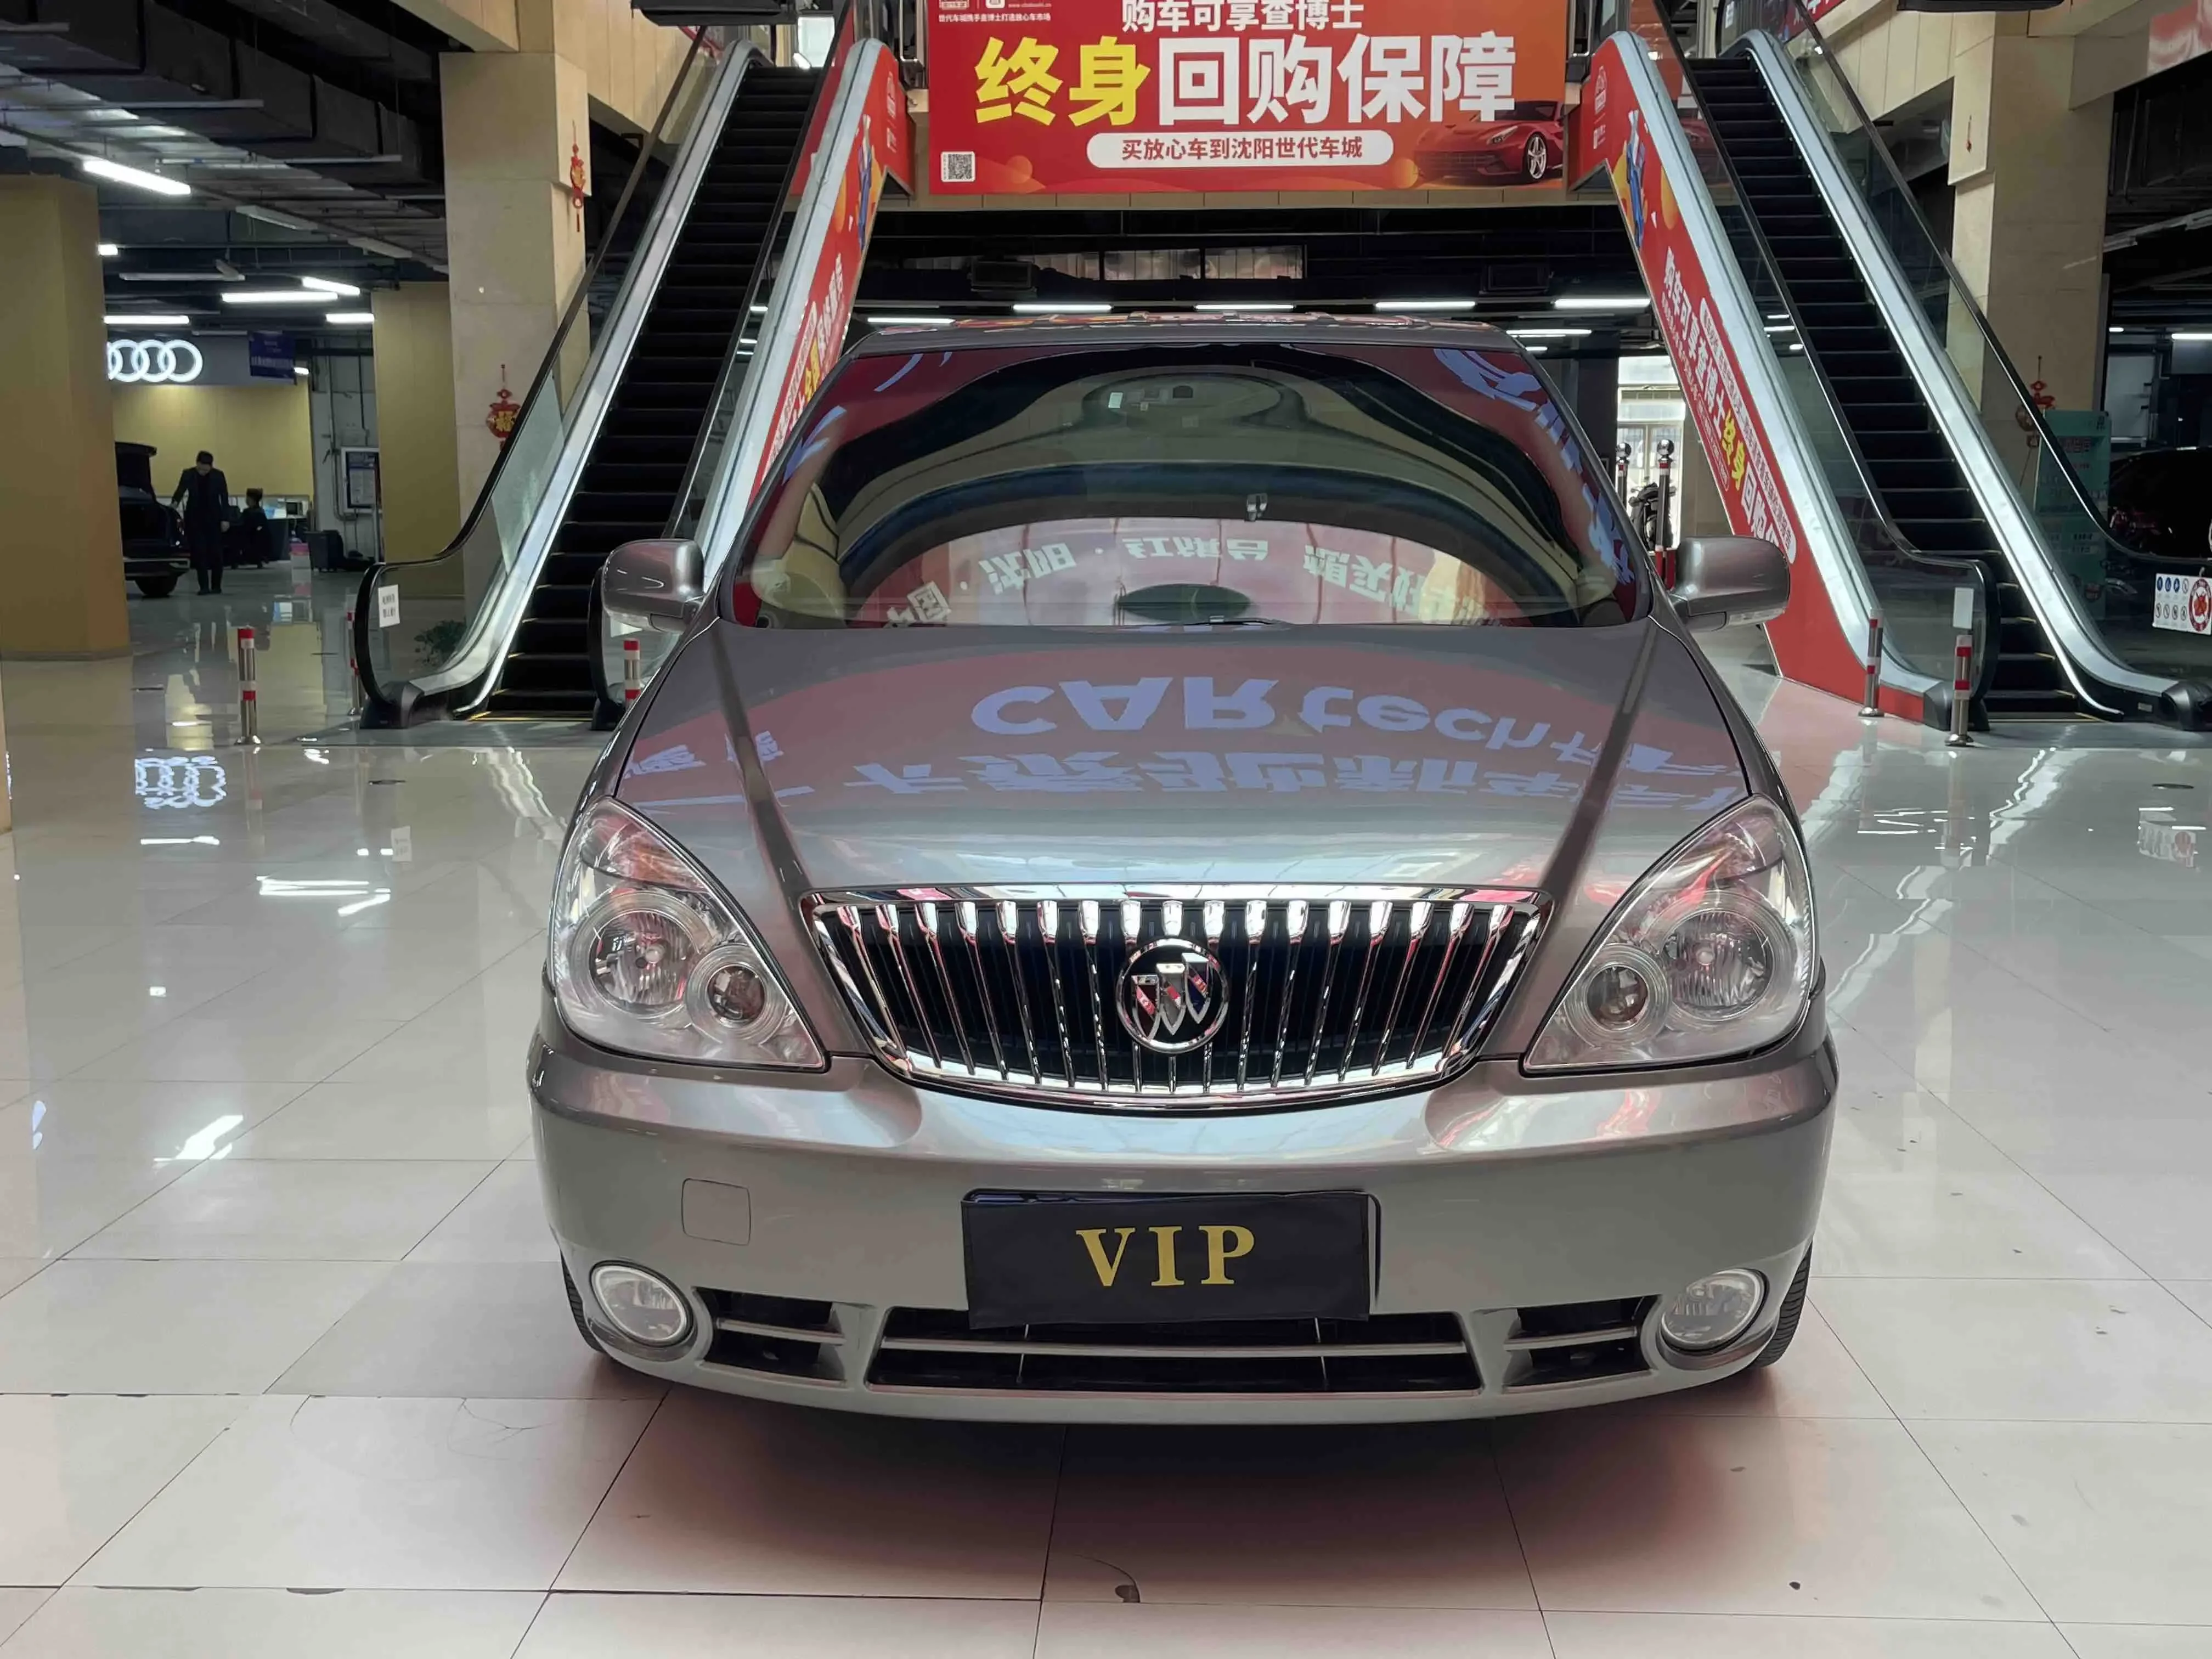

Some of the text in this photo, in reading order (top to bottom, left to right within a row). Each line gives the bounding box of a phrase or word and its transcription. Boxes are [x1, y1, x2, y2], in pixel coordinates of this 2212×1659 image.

[1122, 0, 1364, 32] 购车可享查博士
[974, 30, 1517, 126] 终身回购保障
[1122, 137, 1363, 161] 买放心车到沈阳世代车城
[1076, 1225, 1255, 1286] VIP
